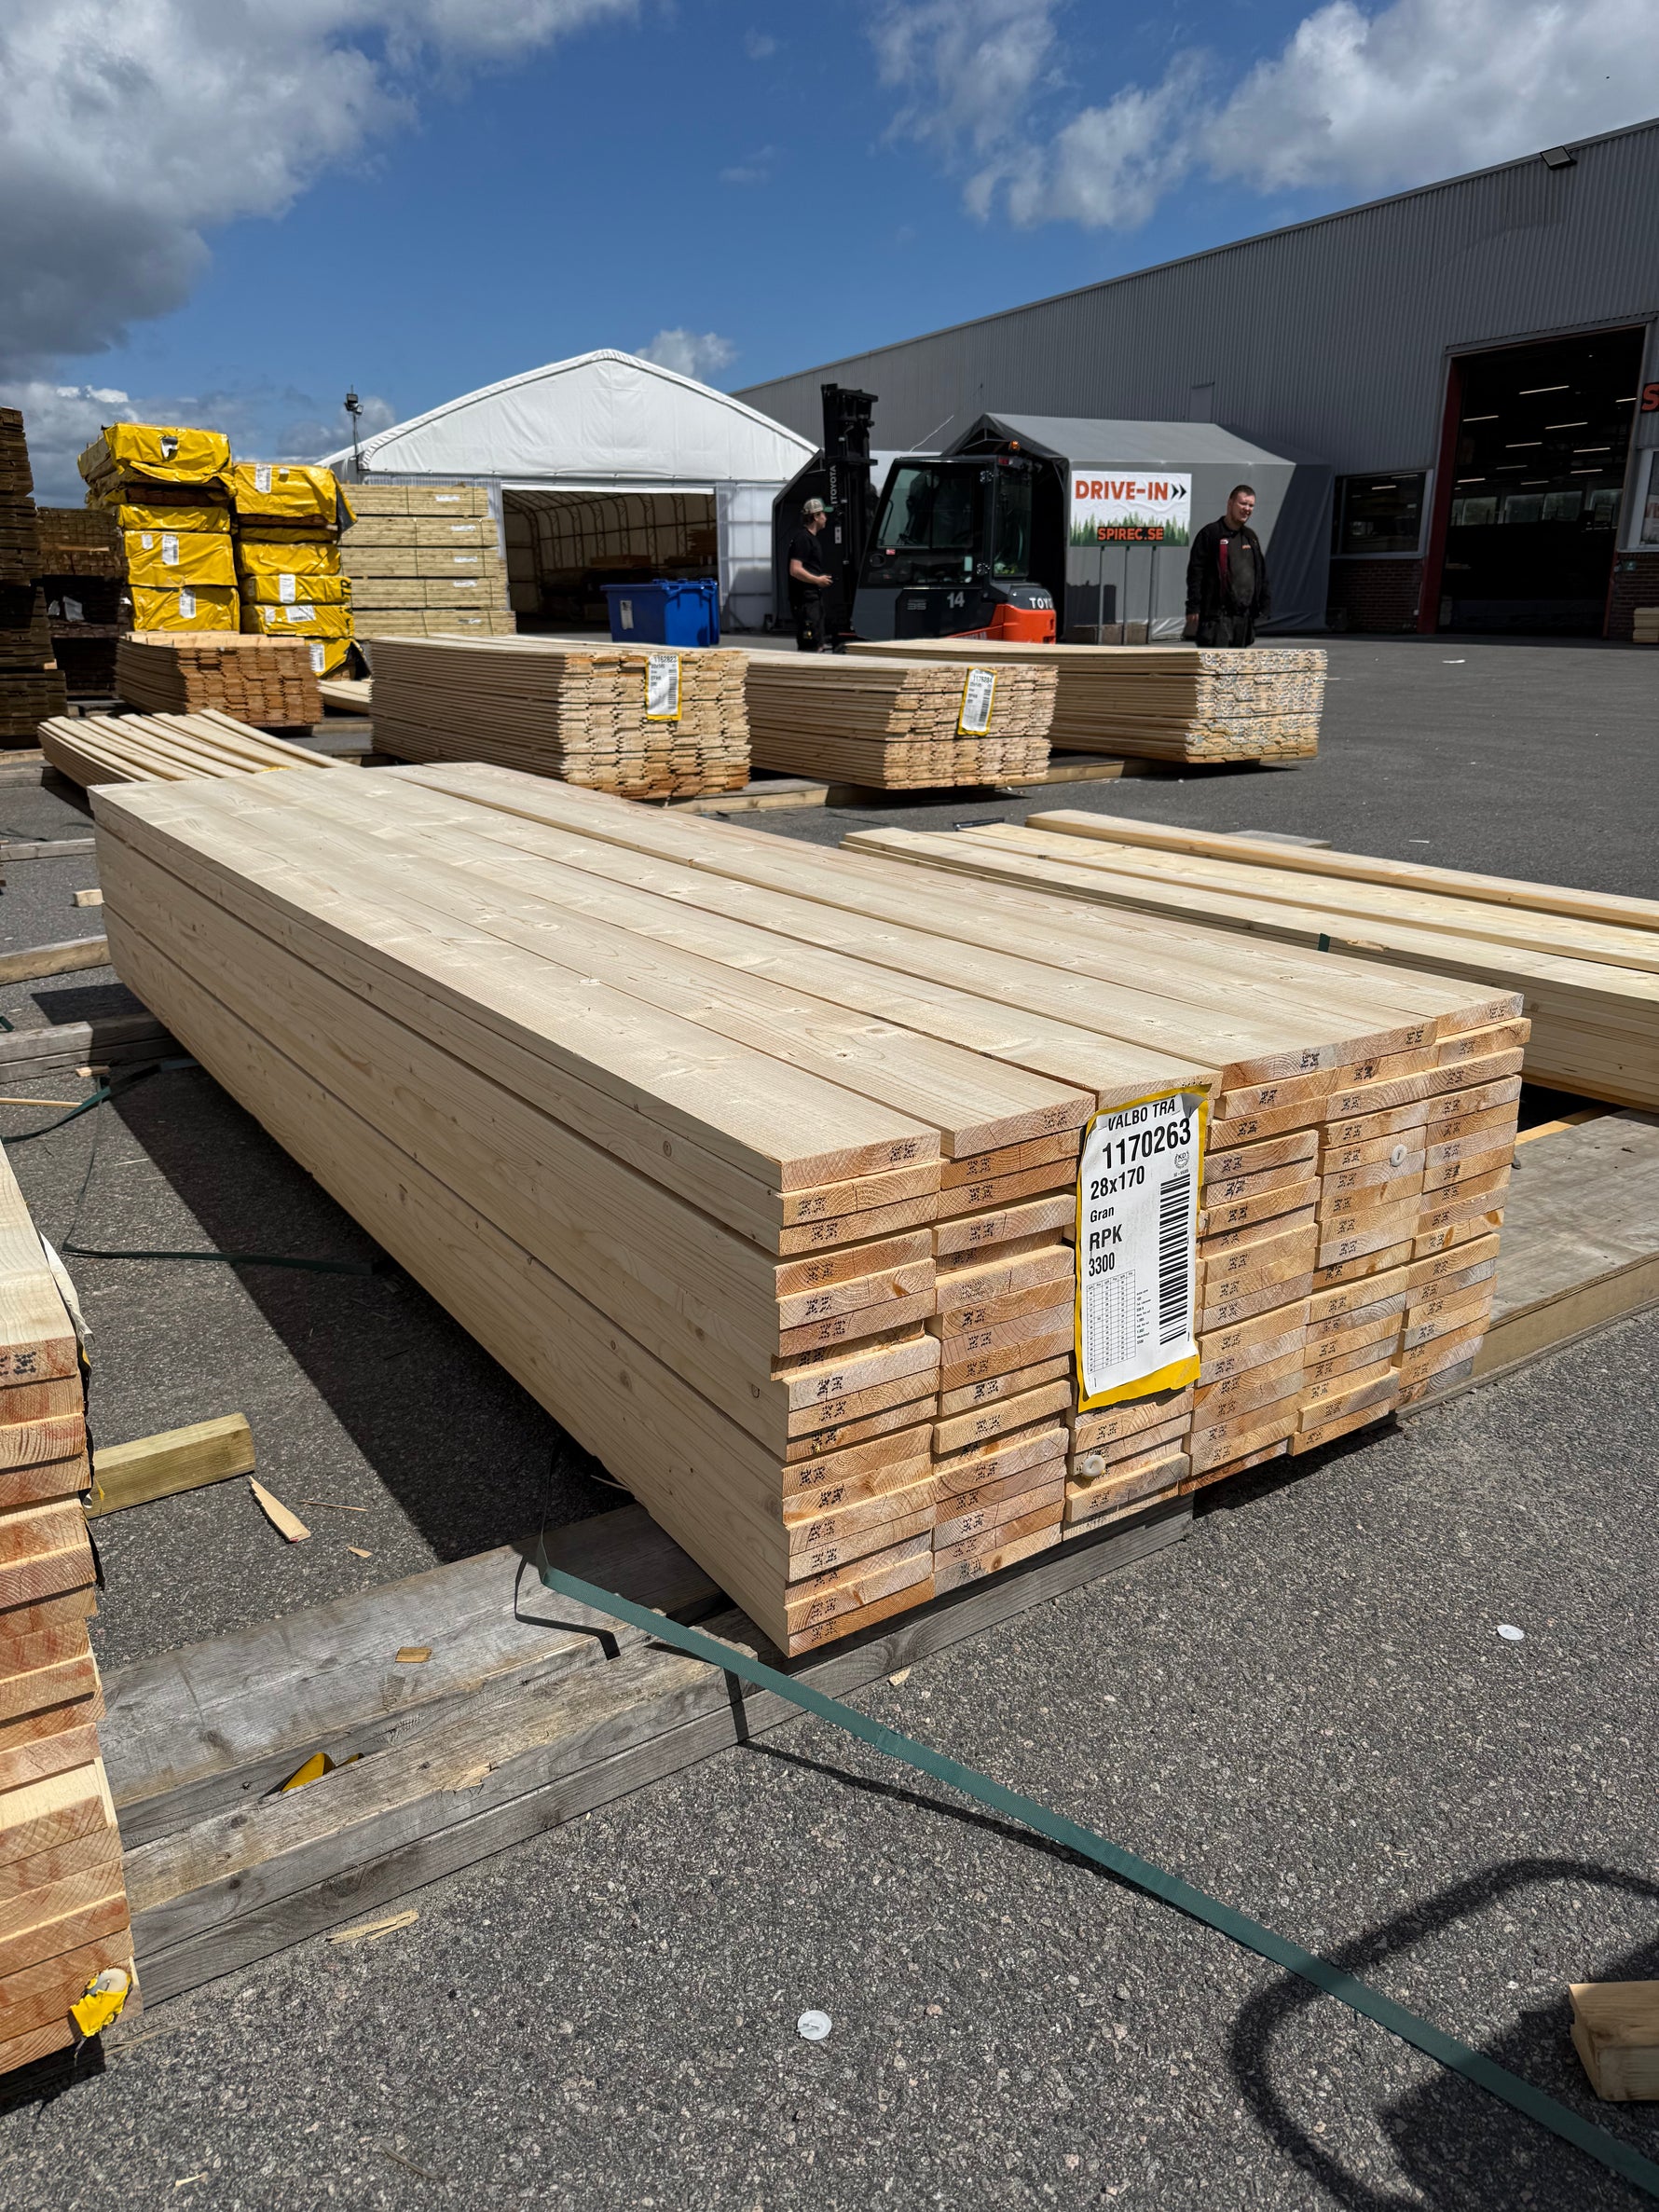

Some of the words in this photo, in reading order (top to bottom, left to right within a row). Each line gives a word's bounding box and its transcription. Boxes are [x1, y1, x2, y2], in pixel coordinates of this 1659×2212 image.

[1076, 480, 1168, 501] DRIVE-IN
[1098, 528, 1164, 541] SPIREC.SE
[947, 591, 966, 608] 14
[1108, 1109, 1148, 1131] VALBO
[1152, 1095, 1175, 1117] TRÄ
[1102, 1118, 1191, 1169] 1170263
[1090, 1165, 1145, 1201] 28x170
[1090, 1206, 1115, 1223] Gran
[1089, 1223, 1123, 1252] RPK
[1089, 1252, 1116, 1277] 3300
